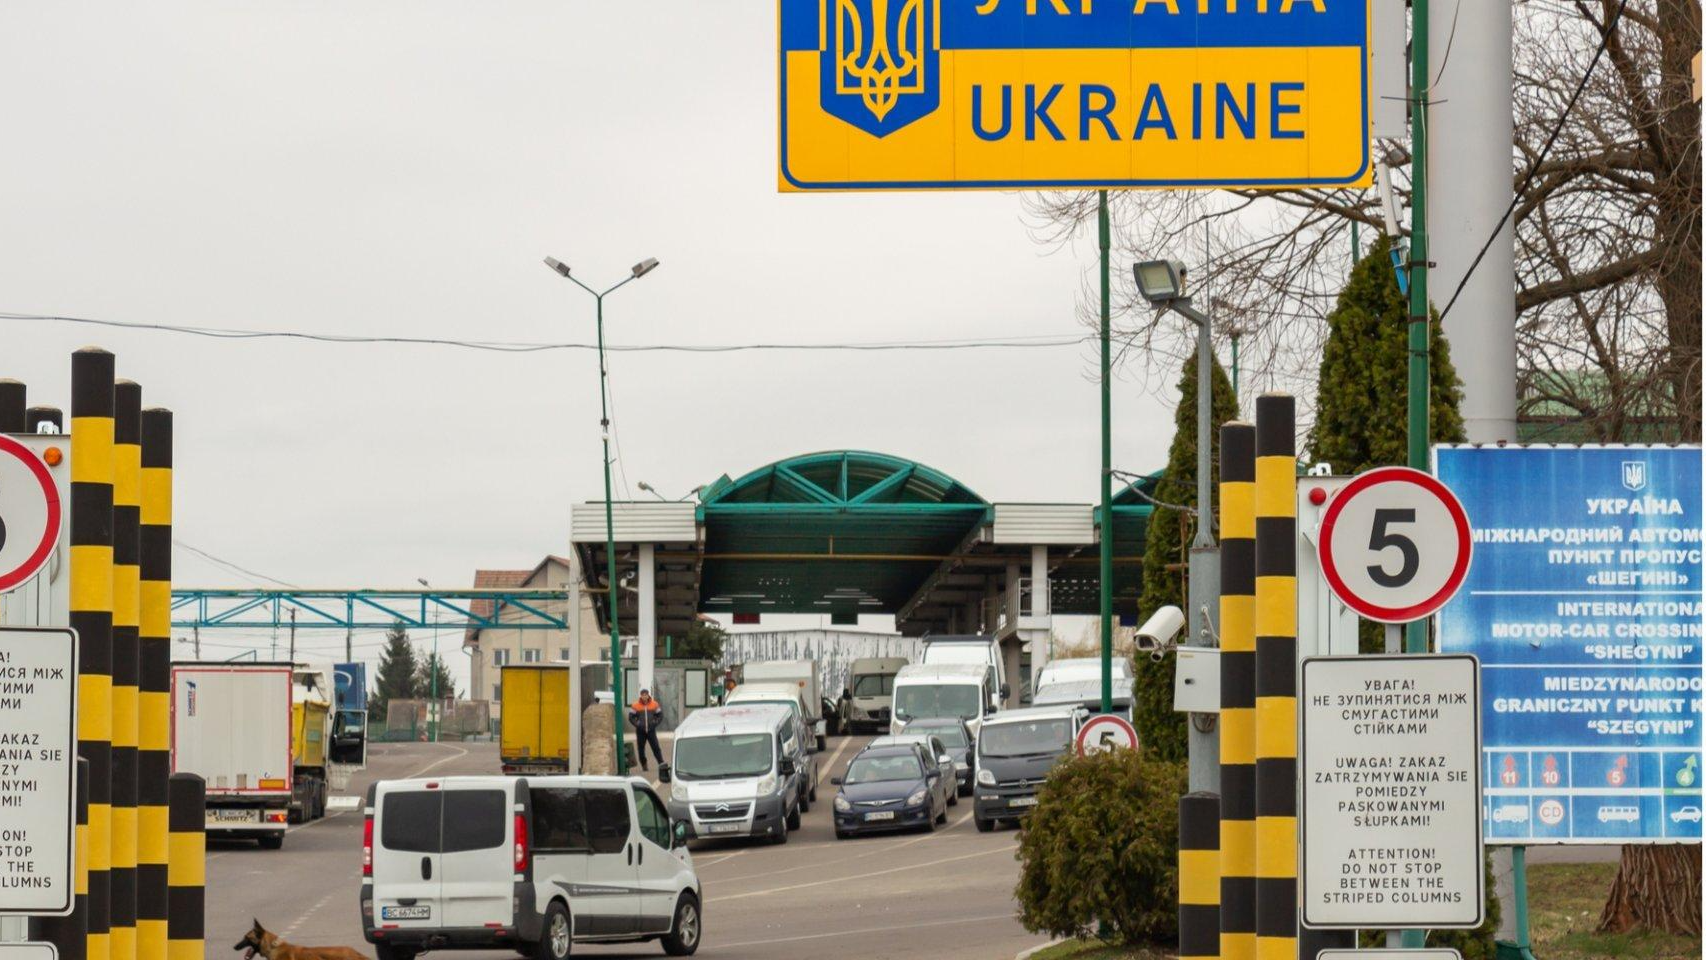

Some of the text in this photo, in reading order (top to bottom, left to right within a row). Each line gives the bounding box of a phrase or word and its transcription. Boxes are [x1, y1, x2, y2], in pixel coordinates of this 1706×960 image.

[970, 81, 1306, 142] UKRAINE
[1587, 495, 1683, 516] УКРАЇНА
[1629, 529, 1702, 542] АВТОМ
[1366, 508, 1420, 588] 5
[1549, 550, 1701, 564] ПУНКТ ПРОПУС
[1587, 572, 1688, 585] «ШЕГИНІ»
[1558, 602, 1702, 616] INTERNATIONA
[1492, 623, 1702, 638] MOTOR-CAR CROSSIN
[33, 667, 64, 680] МІЖ
[0, 682, 34, 694] ИМИ
[1364, 679, 1415, 691] УВАГА!
[1544, 677, 1702, 691] MIEDZYNARODO
[1313, 693, 1467, 707] НЕ ЗУПИНЯТИСЯ МІЖ
[1493, 698, 1611, 713] GRANICZNY
[1616, 698, 1686, 713] PUNKT
[1341, 708, 1439, 721] СМУГАСТИМИ
[1353, 721, 1427, 735] СТІЙКАМИ
[40, 749, 61, 761] SIE
[1335, 756, 1446, 769] UWAGA! ZAKAZ
[1315, 770, 1468, 783] ZATRZYMYWANIA SIE
[1503, 770, 1516, 785] 11
[1543, 770, 1558, 785] 10
[1612, 770, 1621, 783] 5
[1680, 770, 1690, 783] 4
[1356, 785, 1427, 798] POMIEDZY
[1338, 800, 1445, 812] PASKOWANYMI
[1541, 806, 1563, 819] CD
[1354, 815, 1430, 827] SŁUPKAMI!
[1348, 848, 1436, 860] ATTENTION!
[7, 861, 34, 873] THE
[1342, 862, 1442, 875] DO NOT STOP
[2, 876, 52, 888] LUMNS
[1340, 877, 1444, 889] BETWEEN THE
[1323, 891, 1462, 904] STRIPED COLUMNS
